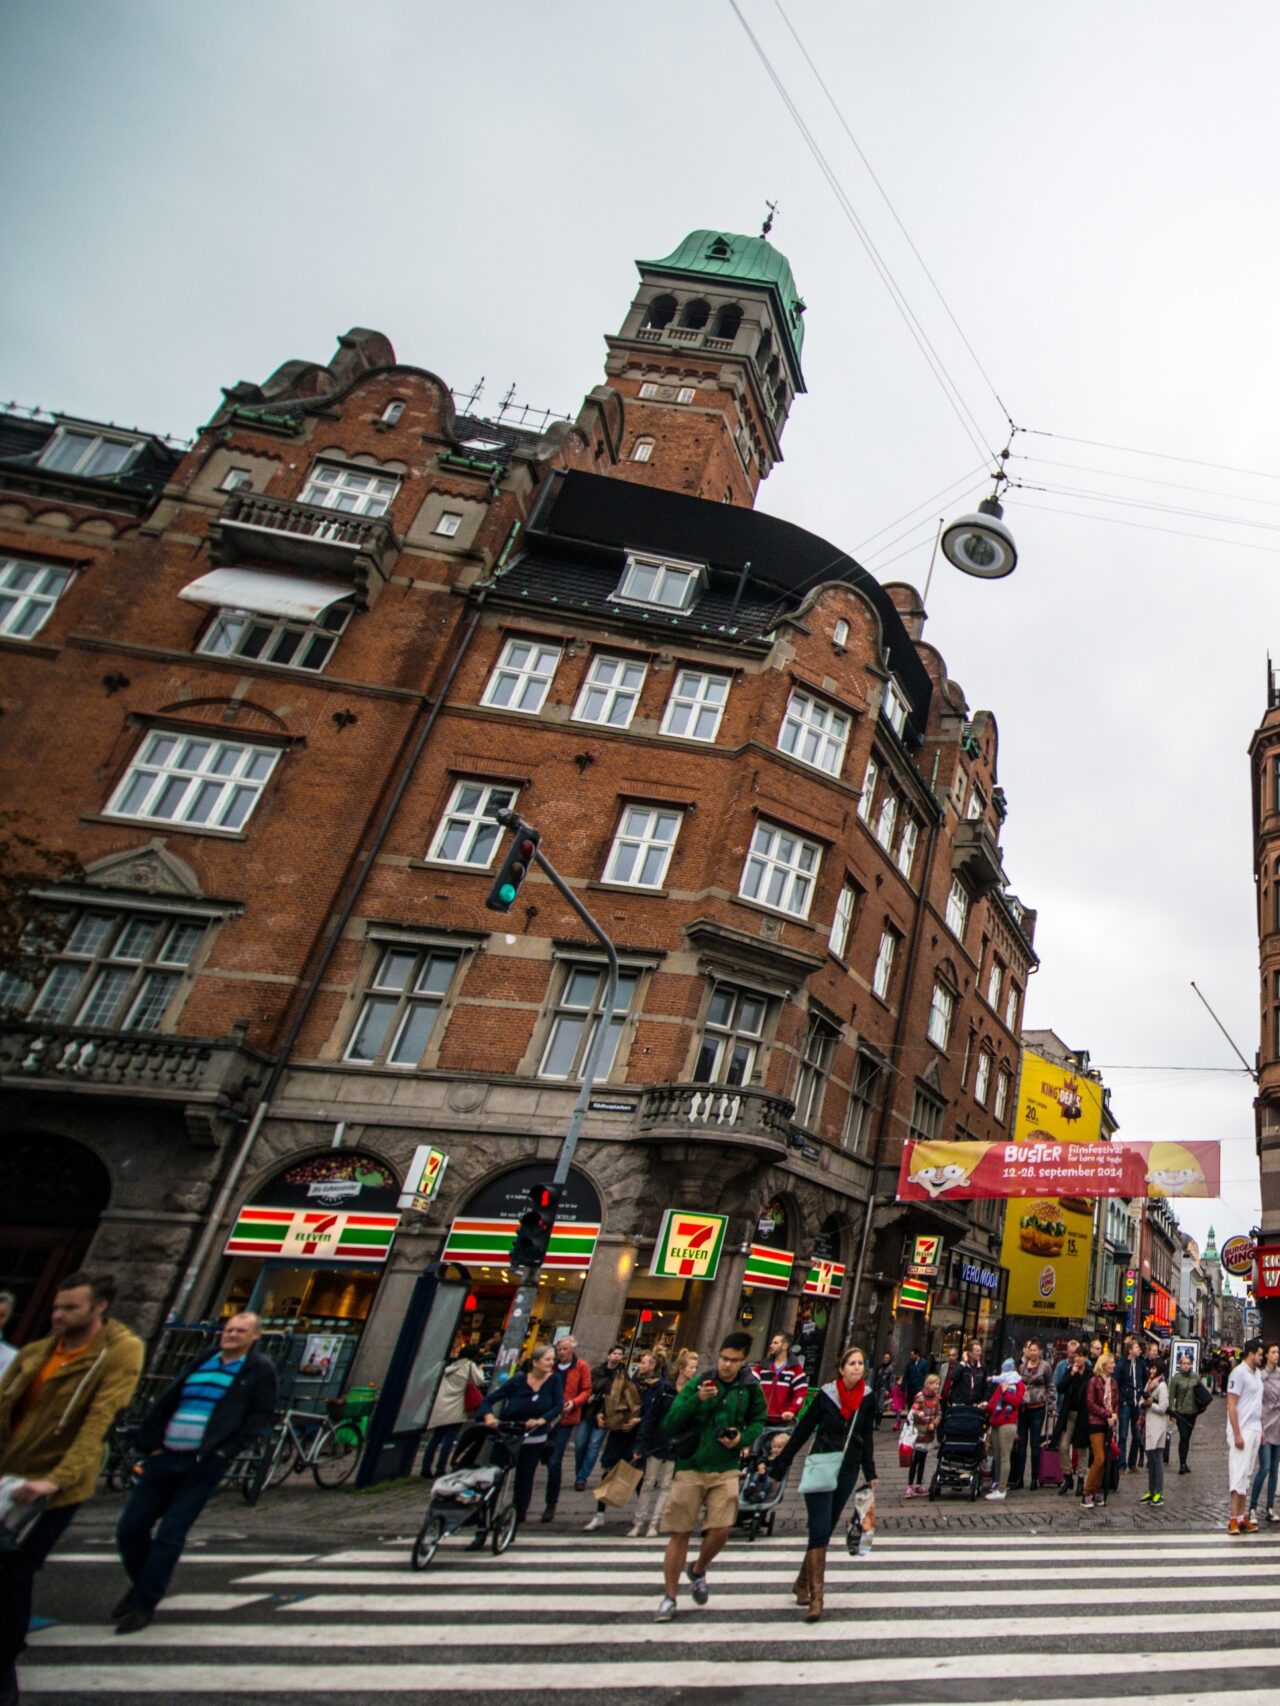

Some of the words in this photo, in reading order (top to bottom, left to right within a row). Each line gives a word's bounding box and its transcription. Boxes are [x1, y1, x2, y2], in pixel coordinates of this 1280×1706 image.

[1041, 1081, 1058, 1100] KING
[1068, 1144, 1123, 1155] filmfestival
[1068, 1154, 1077, 1163] for
[1079, 1153, 1095, 1163] børn
[1039, 1165, 1094, 1180] september
[1098, 1166, 1123, 1178] 2014
[1225, 1242, 1254, 1258] BURGER
[1226, 1250, 1256, 1267] KING
[962, 1264, 979, 1283] VERO
[981, 1269, 998, 1288] MODA
